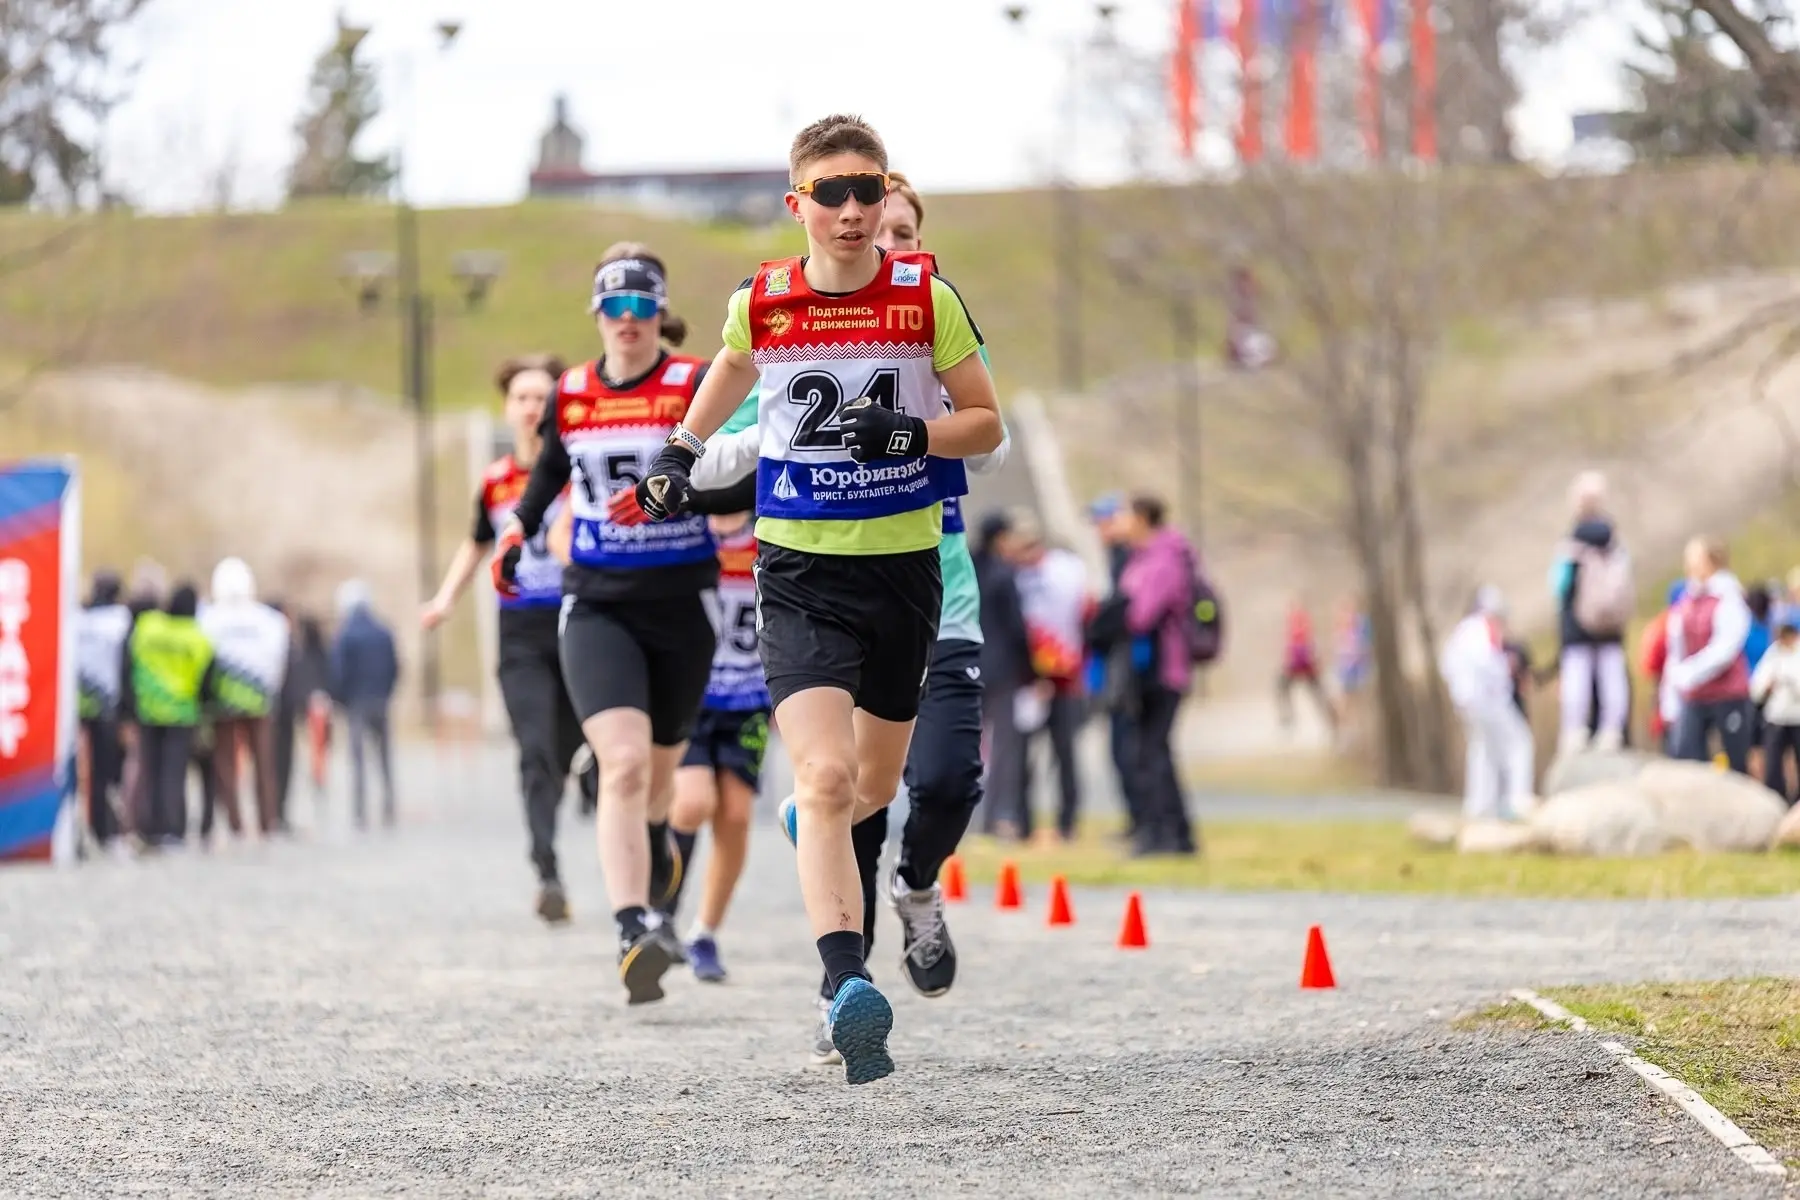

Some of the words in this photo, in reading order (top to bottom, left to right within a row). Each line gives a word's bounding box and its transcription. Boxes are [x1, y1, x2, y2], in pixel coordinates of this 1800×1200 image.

[808, 305, 874, 318] Подтянись
[886, 305, 924, 330] ГТО
[802, 321, 809, 330] к
[812, 317, 880, 331] движению!
[787, 368, 906, 451] 24
[574, 450, 662, 506] 15
[813, 492, 846, 501] ЮРИСТ.
[847, 486, 897, 500] БУХГАЛТЕР.
